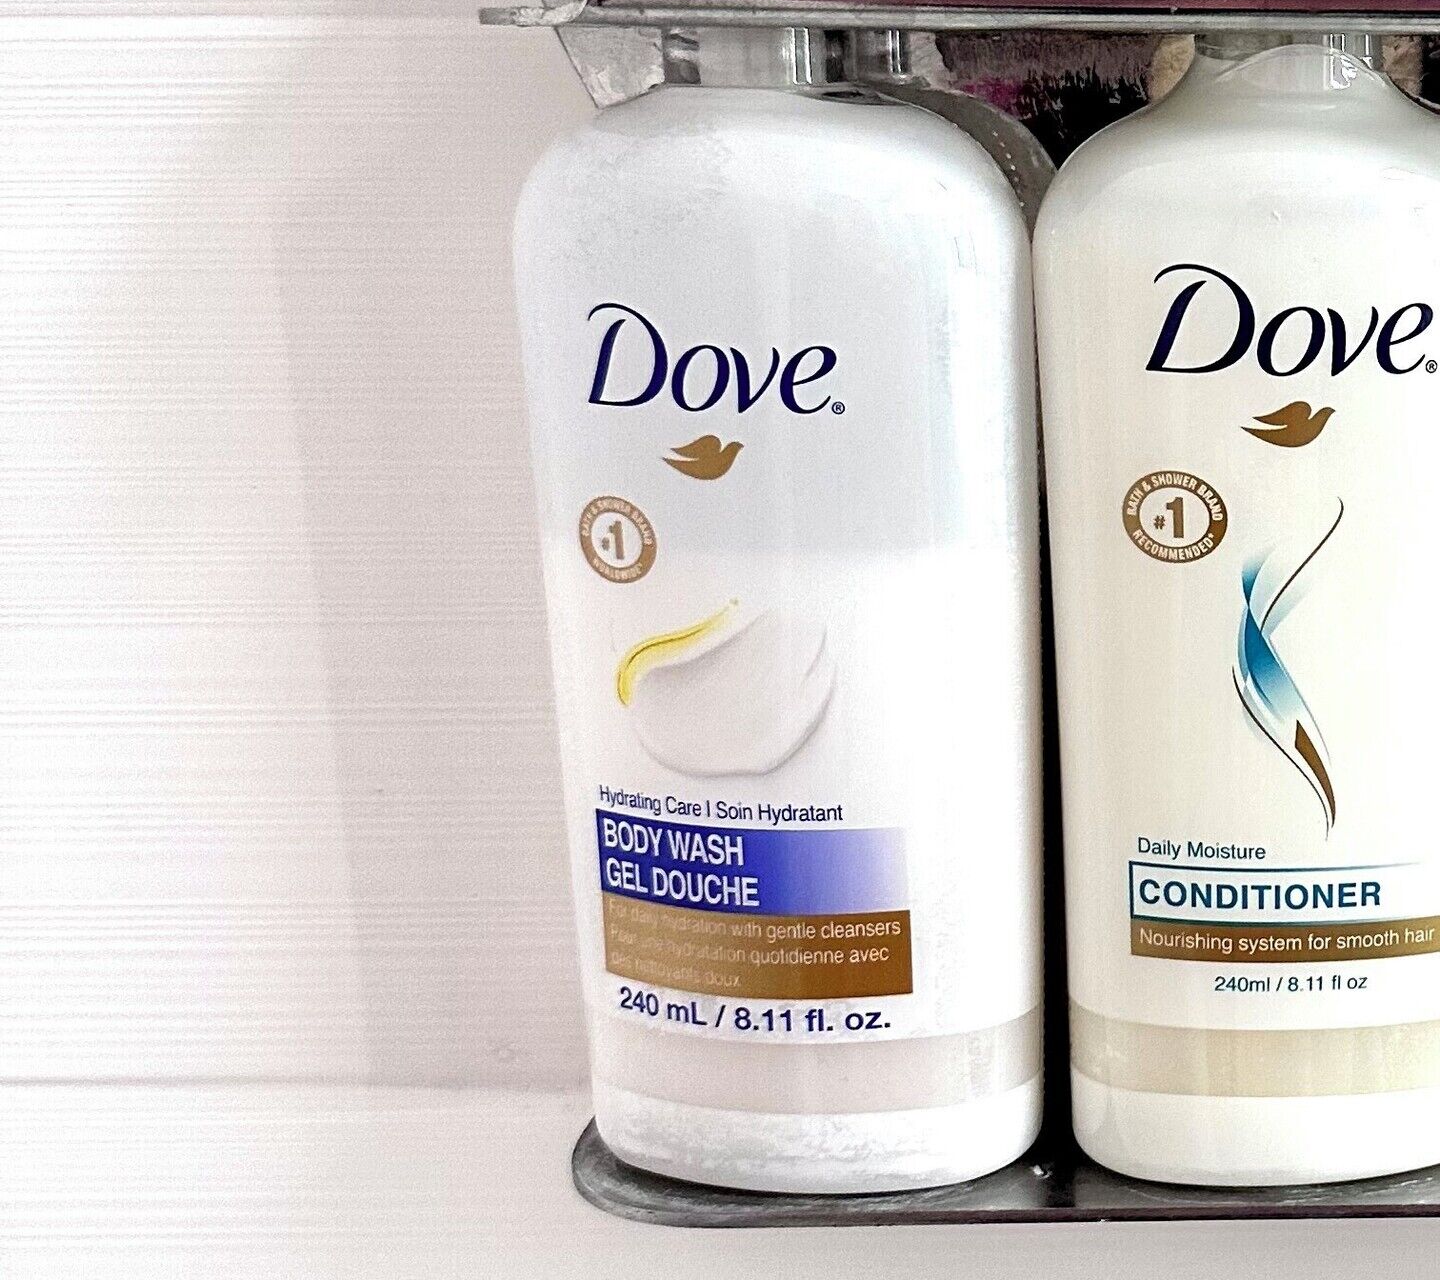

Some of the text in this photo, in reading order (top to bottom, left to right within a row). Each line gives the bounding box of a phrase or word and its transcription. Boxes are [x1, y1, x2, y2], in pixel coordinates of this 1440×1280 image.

[1151, 473, 1198, 490] SHOWER
[1196, 484, 1224, 521] BRAND
[1153, 496, 1185, 539] #1
[599, 784, 661, 815] Hydrating
[665, 796, 701, 818] Care
[716, 800, 753, 820] Soin
[758, 804, 843, 826] Hydratant
[603, 818, 744, 866] BODY WASH
[1137, 837, 1266, 860] Daily Moisture
[606, 857, 760, 907] GEL DOUCHE
[1138, 878, 1382, 910] CONDITIONER
[731, 921, 762, 937] with
[767, 923, 815, 944] gentle
[820, 920, 901, 939] cleansers
[1139, 925, 1435, 956] Nourishing system for smooth hair
[750, 946, 845, 967] quotidienne
[849, 946, 889, 963] avec
[1214, 974, 1368, 993] 240ml / 8.11 fl oz
[620, 986, 892, 1032] 240 mL / 8.11 fl. oz.
